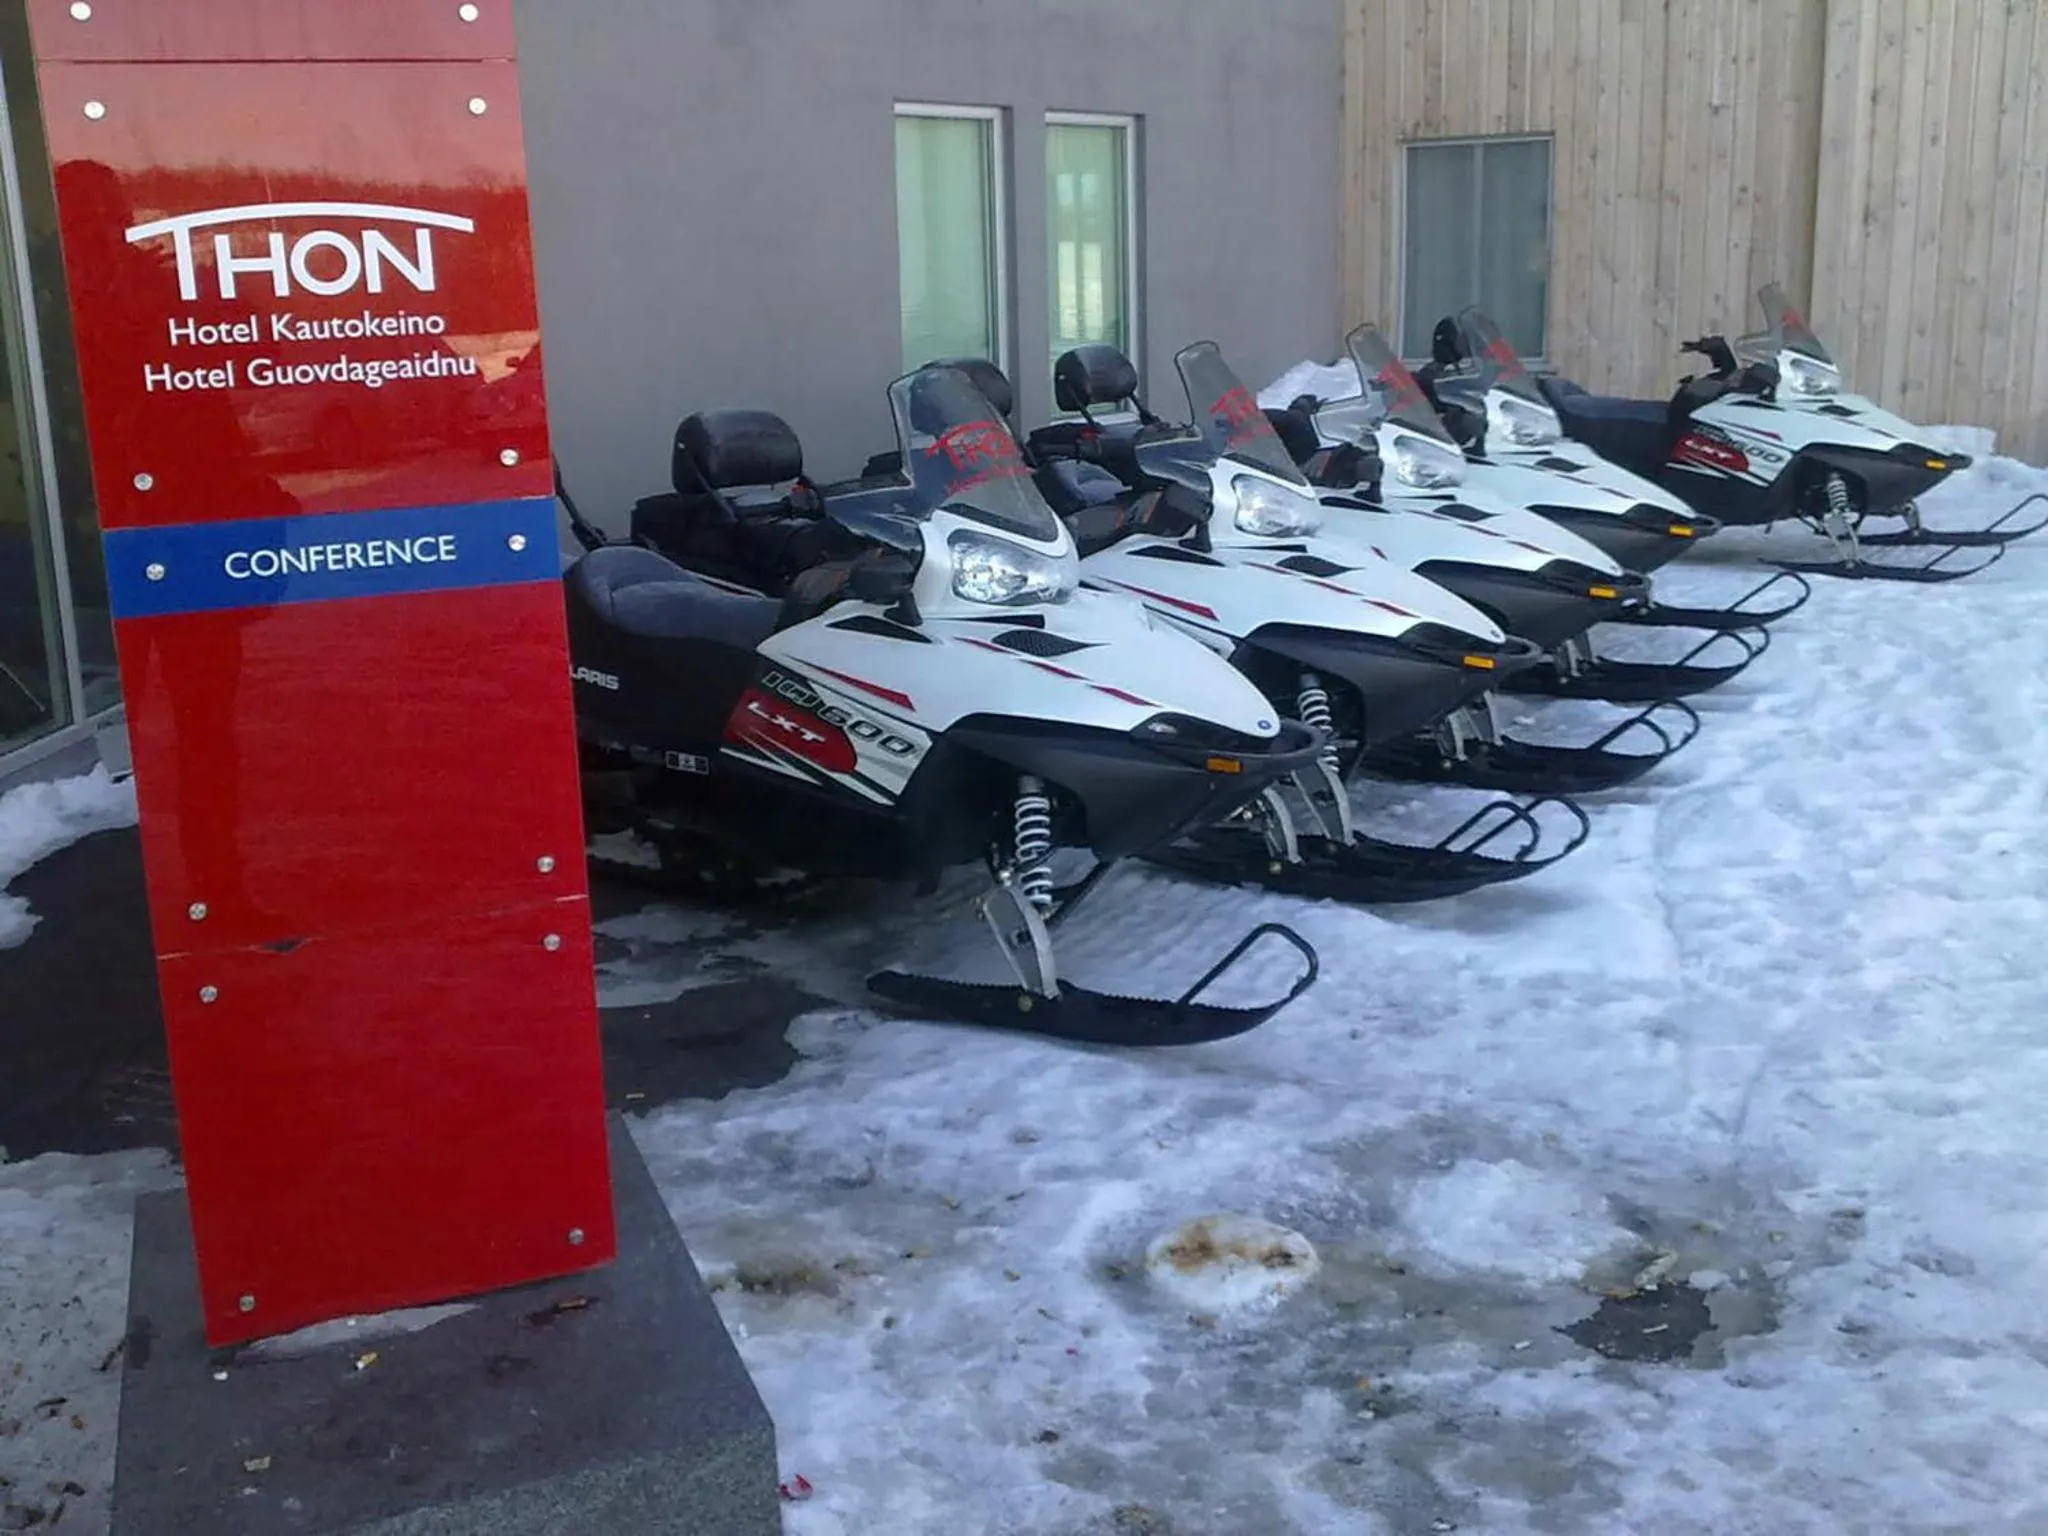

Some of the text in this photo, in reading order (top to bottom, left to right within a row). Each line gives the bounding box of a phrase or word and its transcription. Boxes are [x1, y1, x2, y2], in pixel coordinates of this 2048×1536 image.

[125, 202, 474, 301] THON
[169, 311, 444, 345] Hotel Kautokeino
[145, 351, 476, 391] Hotel Guovdageaidnu
[225, 535, 456, 578] CONFERENCE
[748, 702, 825, 742] LXT
